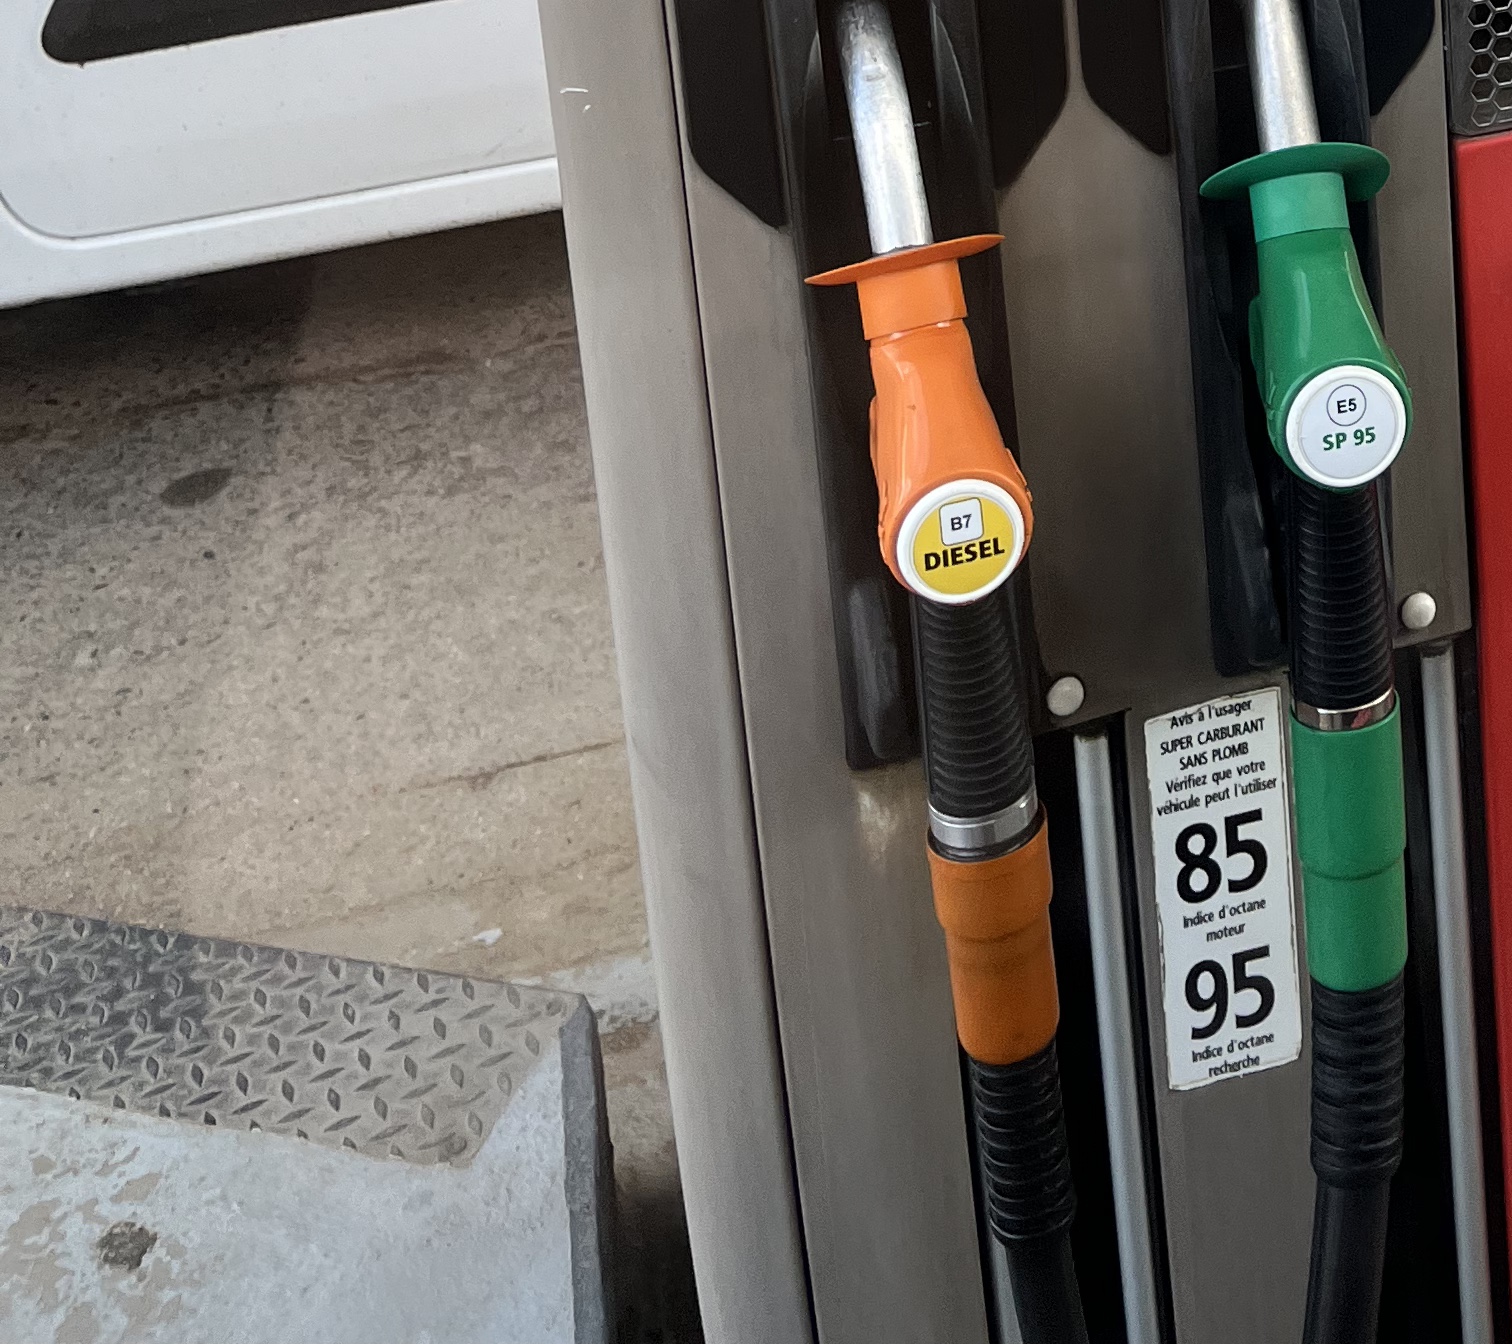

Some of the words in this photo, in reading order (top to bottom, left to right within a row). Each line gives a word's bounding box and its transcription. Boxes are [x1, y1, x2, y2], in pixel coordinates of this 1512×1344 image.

[1337, 398, 1357, 414] E5
[1323, 432, 1347, 451] SP
[1353, 426, 1376, 446] 95
[950, 514, 972, 531] B7
[924, 537, 1005, 571] DIESEL
[1170, 707, 1194, 730] Avis
[1198, 705, 1205, 722] à
[1208, 698, 1252, 721] l'usager
[1160, 735, 1193, 755] SUPER
[1197, 718, 1265, 745] CARBURANT
[1179, 752, 1208, 770] SANS
[1212, 741, 1249, 764] PLOMB
[1165, 773, 1207, 795] Vérifiez
[1212, 768, 1233, 785] que
[1237, 758, 1266, 776] votre
[1156, 796, 1200, 817] véhicule
[1204, 787, 1230, 809] peut
[1234, 776, 1277, 797] l'utiliser
[1175, 808, 1268, 904] 85
[1183, 910, 1214, 930] Indice
[1218, 896, 1266, 918] d'octane
[1206, 923, 1245, 943] moteur
[1185, 944, 1275, 1040] 95
[1192, 1043, 1223, 1063] Indice
[1227, 1032, 1274, 1054] d'octane
[1208, 1054, 1260, 1078] recherche
